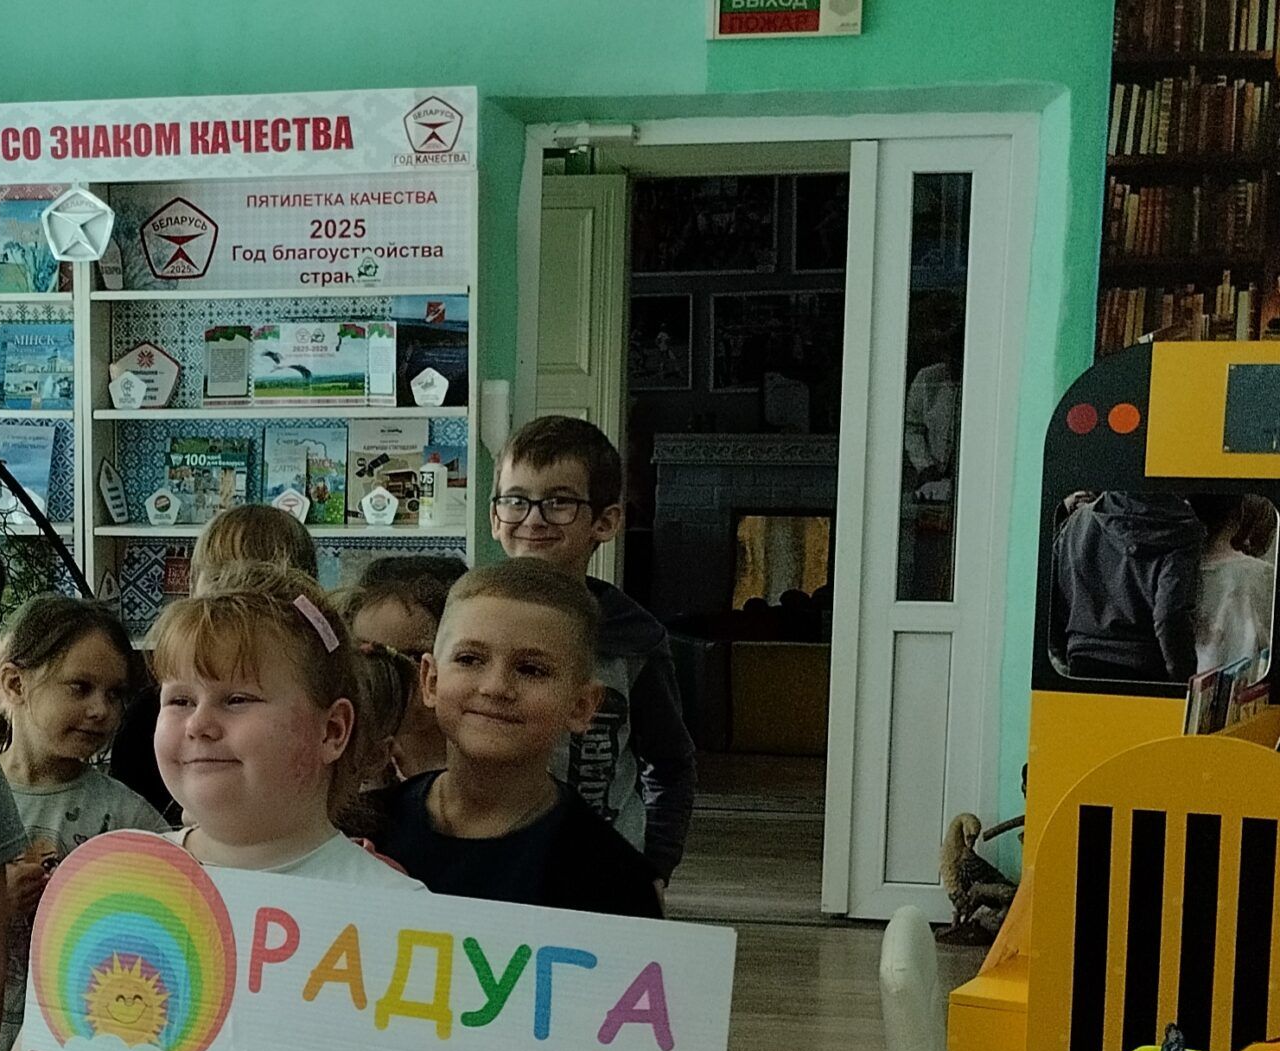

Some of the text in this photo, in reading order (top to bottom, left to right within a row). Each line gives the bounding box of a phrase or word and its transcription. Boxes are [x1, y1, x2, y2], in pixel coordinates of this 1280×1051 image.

[730, 15, 809, 32] ПОЖАР
[412, 108, 456, 121] БЕЛАРУСЬ
[1, 126, 42, 162] СО
[50, 121, 181, 160] ЗНАКОМ
[190, 115, 355, 155] КАЧЕСТВА
[393, 153, 467, 166] ГОД КАЧЕСТВА
[246, 190, 438, 209] ПЯТИЛЕТКА КАЧЕСТВА
[151, 215, 208, 233] БЕЛАРУСЬ
[309, 219, 366, 239] 2025
[232, 245, 266, 263] Год
[299, 270, 356, 287] стран
[184, 453, 207, 466] 100
